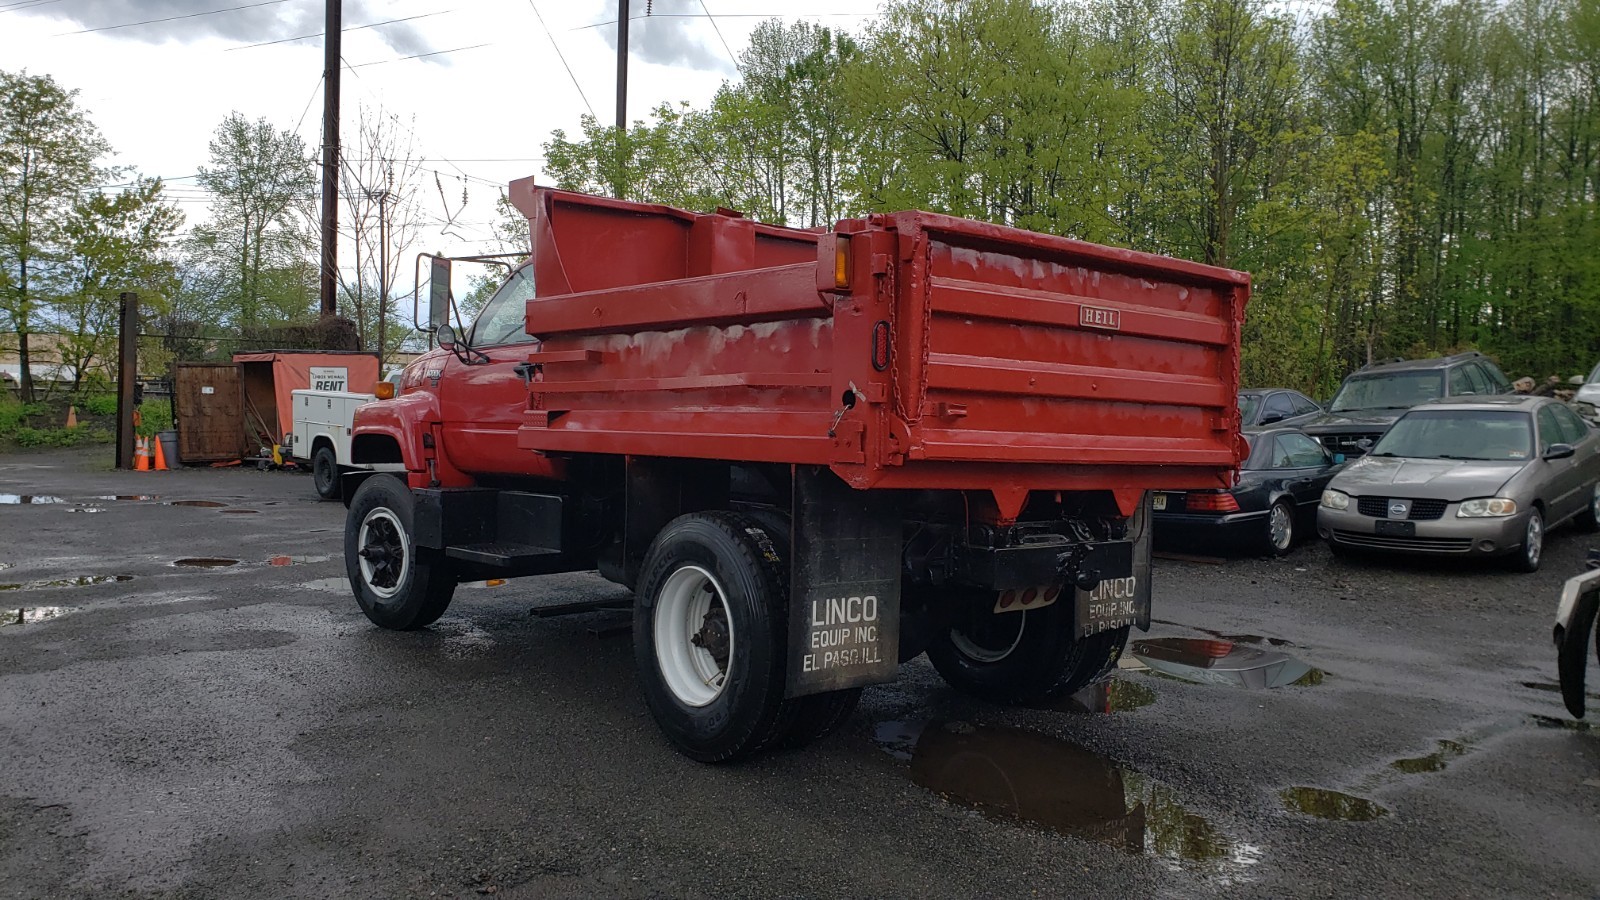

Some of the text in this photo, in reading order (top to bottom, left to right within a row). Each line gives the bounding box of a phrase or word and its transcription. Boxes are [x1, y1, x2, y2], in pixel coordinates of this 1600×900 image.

[1085, 308, 1115, 325] HEIL
[315, 380, 344, 391] RENT
[1090, 576, 1136, 601] LINCO
[812, 596, 877, 626] LINCO
[811, 625, 879, 648] EQUIP INC.
[803, 653, 820, 672] EL
